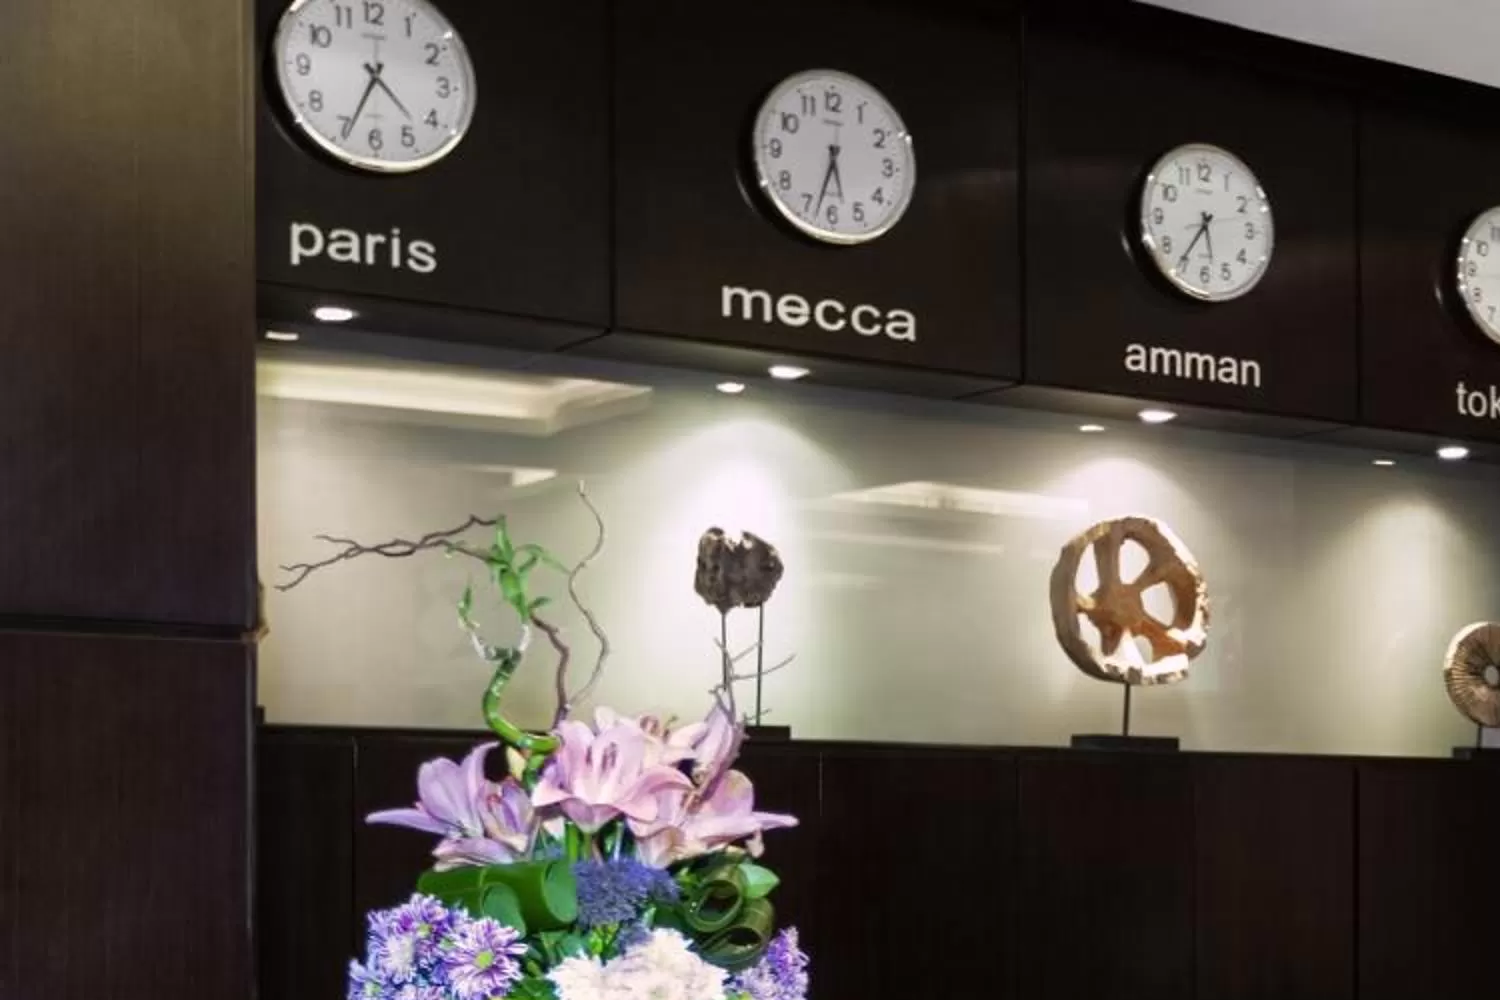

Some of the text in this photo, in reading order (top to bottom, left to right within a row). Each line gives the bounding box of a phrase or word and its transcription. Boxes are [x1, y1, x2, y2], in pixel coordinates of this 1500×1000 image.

[335, 4, 352, 29] 11
[363, 1, 384, 26] 12
[309, 23, 332, 48] 10
[404, 15, 412, 38] 1
[295, 53, 311, 76] 9
[424, 42, 440, 66] 2
[436, 76, 450, 99] 3
[308, 90, 323, 112] 8
[800, 95, 816, 117] 11
[823, 91, 842, 113] 12
[424, 108, 439, 129] 4
[781, 111, 799, 134] 10
[856, 104, 865, 124] 1
[368, 128, 383, 151] 6
[401, 124, 415, 147] 5
[873, 128, 886, 149] 2
[769, 138, 782, 158] 9
[881, 158, 894, 178] 3
[779, 170, 792, 190] 8
[800, 193, 813, 213] 7
[871, 186, 884, 205] 4
[826, 205, 839, 225] 6
[852, 202, 865, 222] 5
[290, 221, 438, 274] paris
[721, 284, 917, 343] mecca
[1124, 342, 1262, 388] amman
